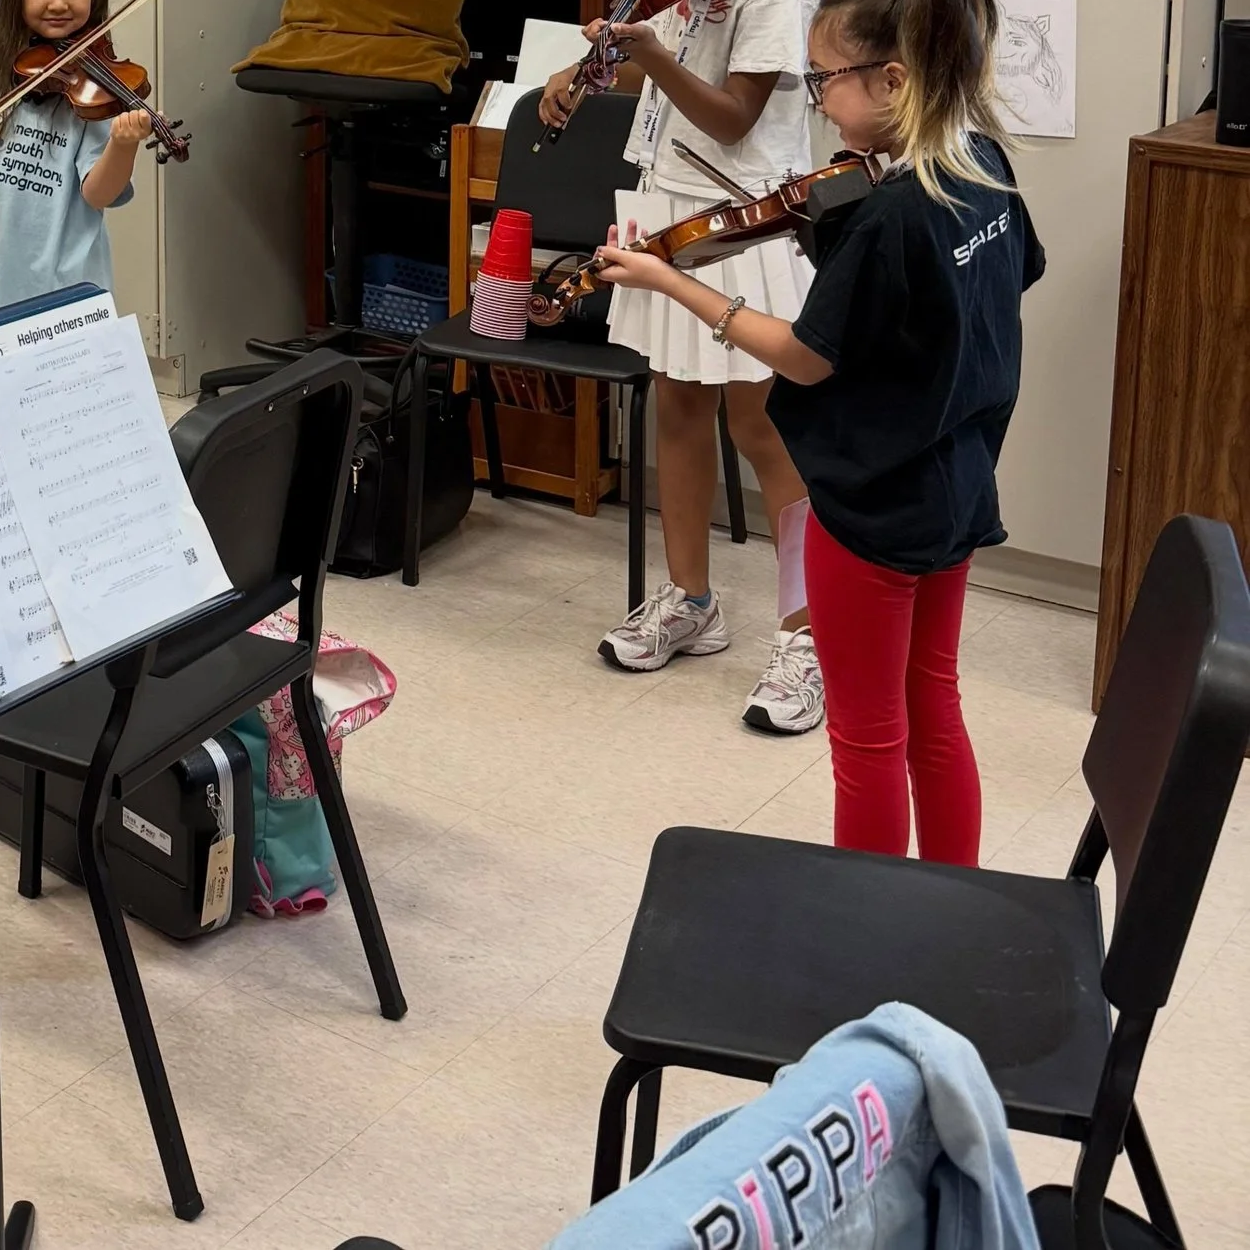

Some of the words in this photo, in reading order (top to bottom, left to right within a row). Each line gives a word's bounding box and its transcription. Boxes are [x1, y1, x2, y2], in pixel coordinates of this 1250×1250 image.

[6, 141, 43, 160] youth
[15, 124, 68, 148] memphis
[2, 156, 62, 186] symphony
[953, 207, 1010, 266] SPACE
[18, 326, 53, 347] Helping
[54, 315, 83, 334] others
[85, 308, 110, 324] make
